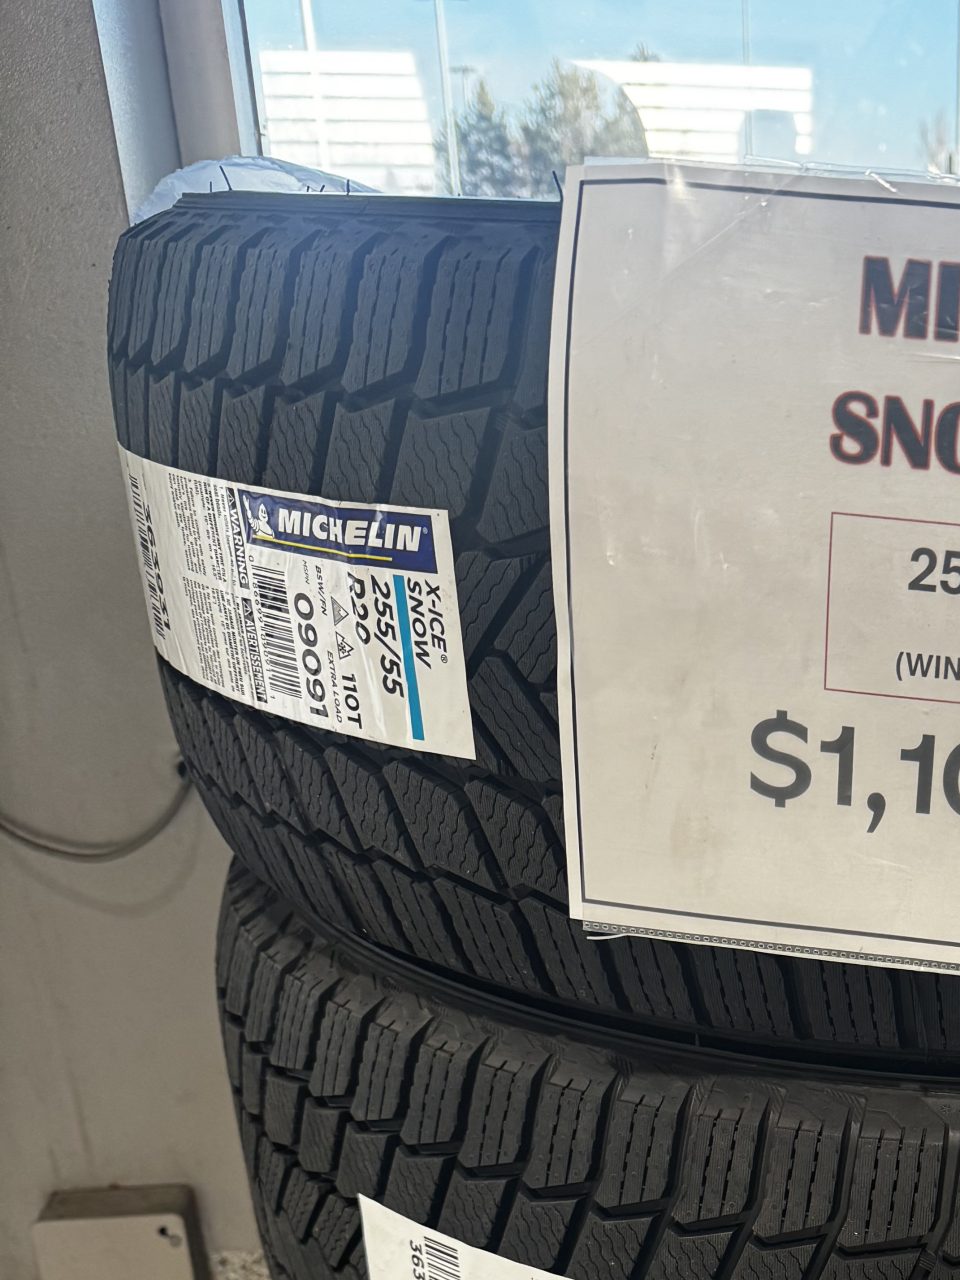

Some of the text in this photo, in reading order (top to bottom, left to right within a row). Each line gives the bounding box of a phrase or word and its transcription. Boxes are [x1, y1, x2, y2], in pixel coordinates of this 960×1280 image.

[230, 508, 249, 586] WARNING
[315, 565, 328, 616] BSW/FN
[349, 572, 371, 645] R20
[407, 577, 432, 669] SNOW
[245, 618, 266, 703] AVERTISSEMENT
[294, 592, 328, 719] 09091
[370, 574, 405, 698] 255/55
[327, 650, 342, 723] EXTRA LOAD
[341, 673, 364, 729] 110T
